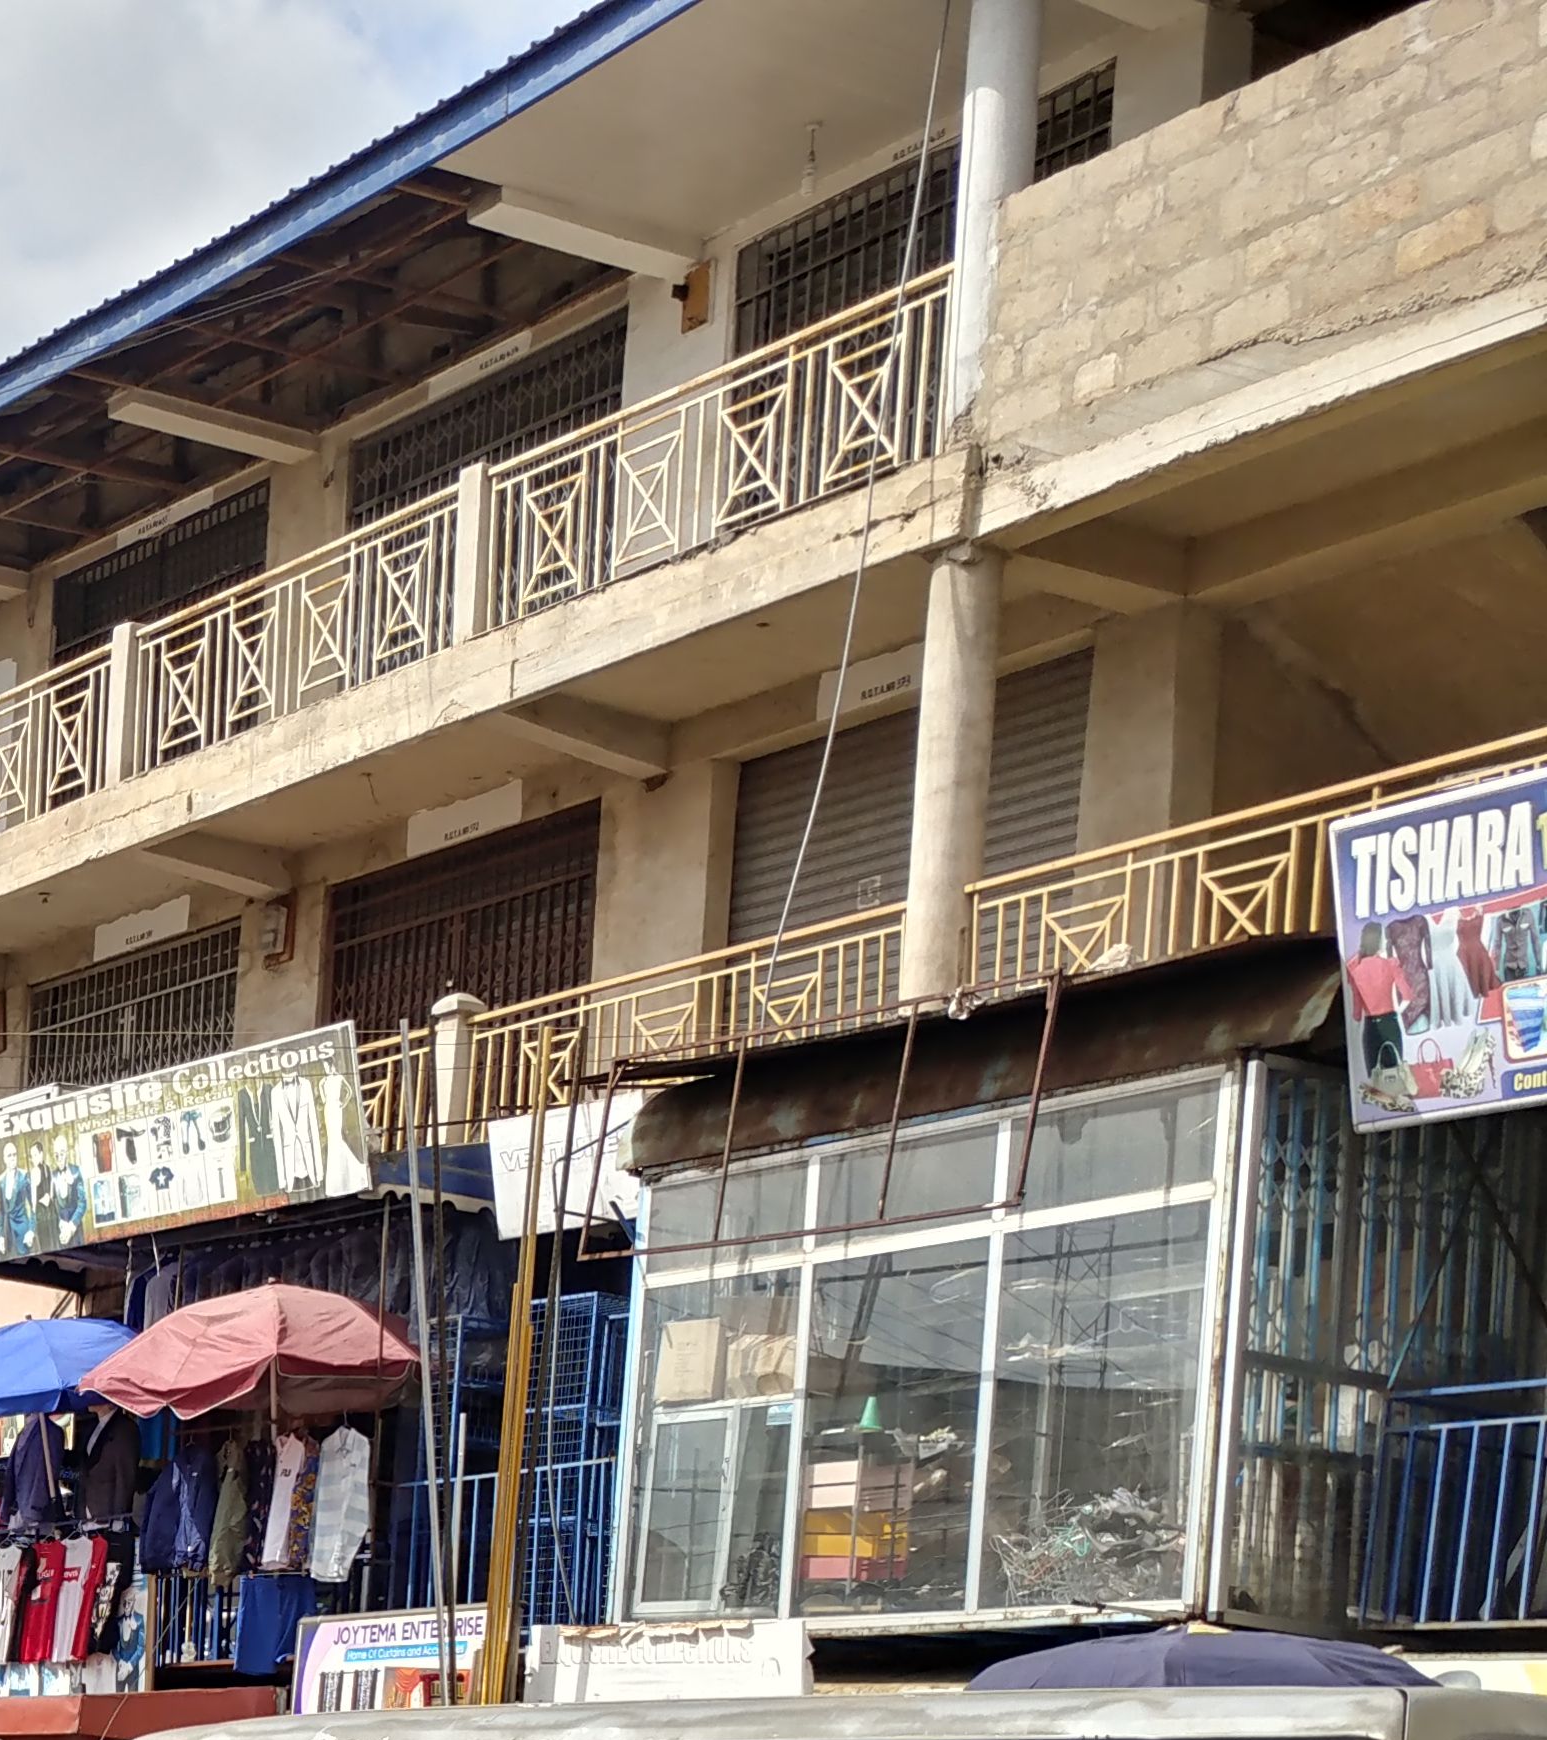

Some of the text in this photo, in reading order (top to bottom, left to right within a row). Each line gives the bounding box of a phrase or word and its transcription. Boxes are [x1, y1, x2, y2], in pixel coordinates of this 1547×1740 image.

[1351, 801, 1535, 920] TISHARA
[173, 1040, 336, 1095] Collections
[77, 1086, 235, 1133] Wholesale & Retail
[334, 1622, 397, 1646] JOYTEMA
[347, 1650, 367, 1660] Home
[368, 1648, 378, 1659] Of
[378, 1647, 406, 1658] Curtains
[407, 1646, 421, 1657] and
